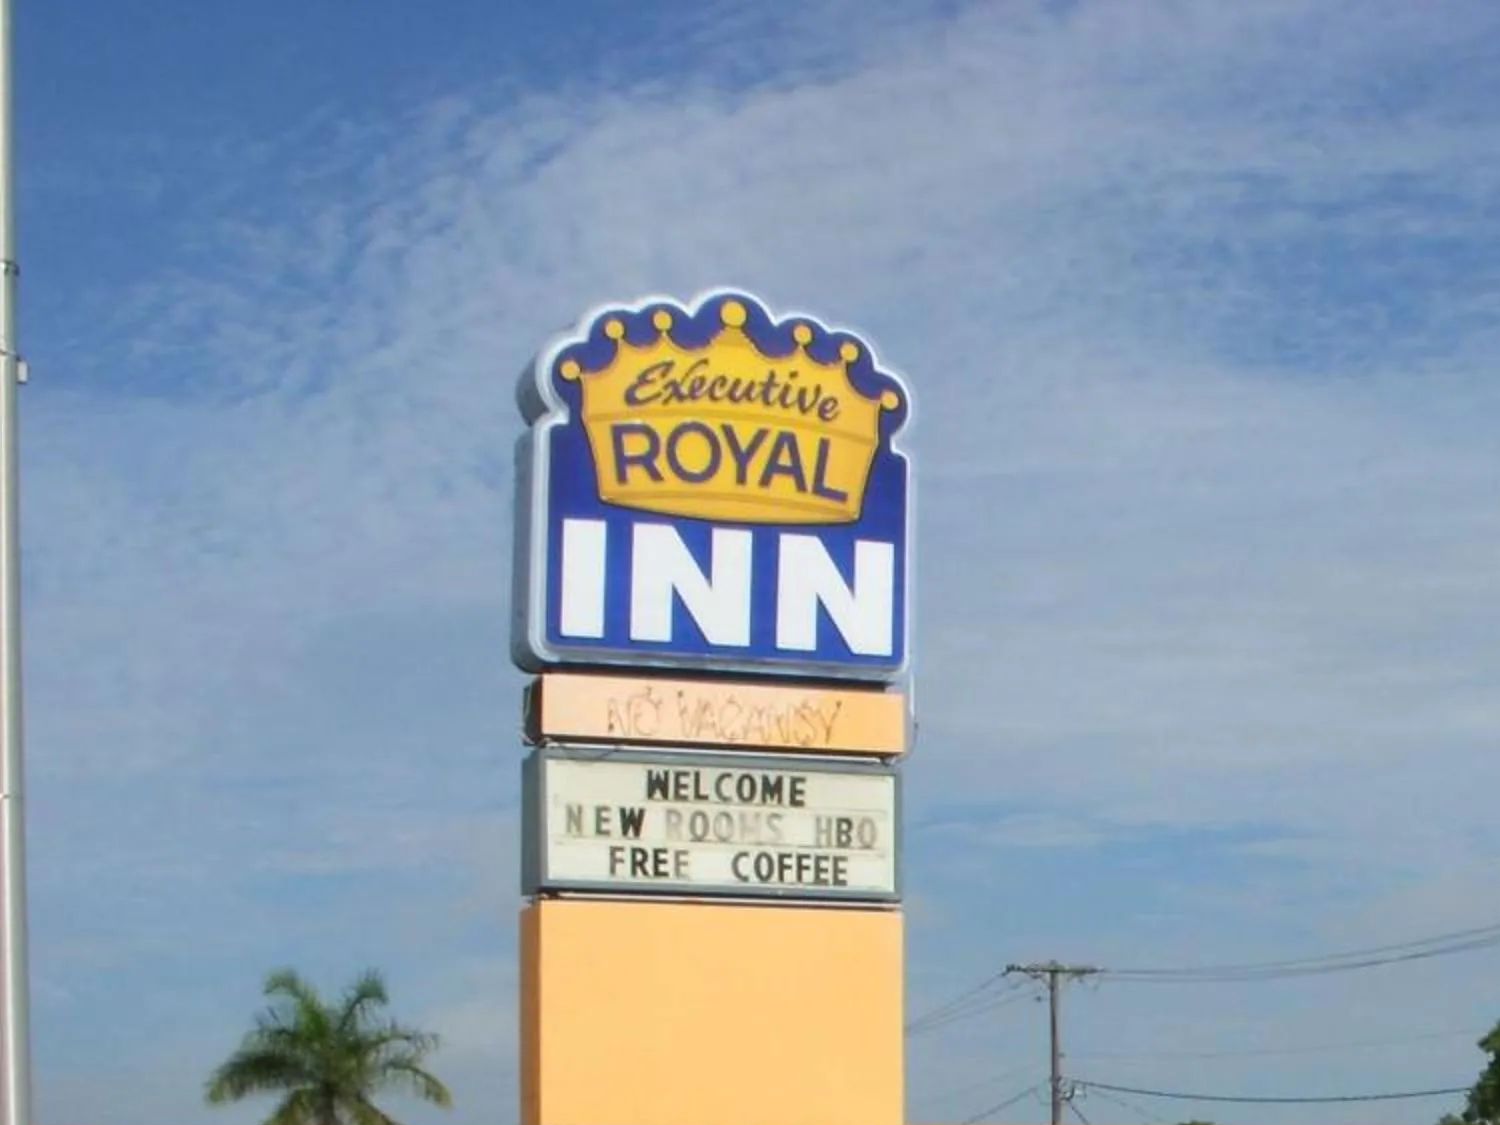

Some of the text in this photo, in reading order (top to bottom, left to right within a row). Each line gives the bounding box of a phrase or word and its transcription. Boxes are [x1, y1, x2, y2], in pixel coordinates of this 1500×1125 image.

[624, 357, 842, 423] Executive
[610, 421, 849, 503] ROYAL
[560, 518, 895, 657] INN
[607, 684, 662, 737] NO
[646, 769, 807, 808] WELCOME
[565, 803, 877, 849] NEW ROOMS HBO
[608, 845, 849, 886] FREE COFFEE
